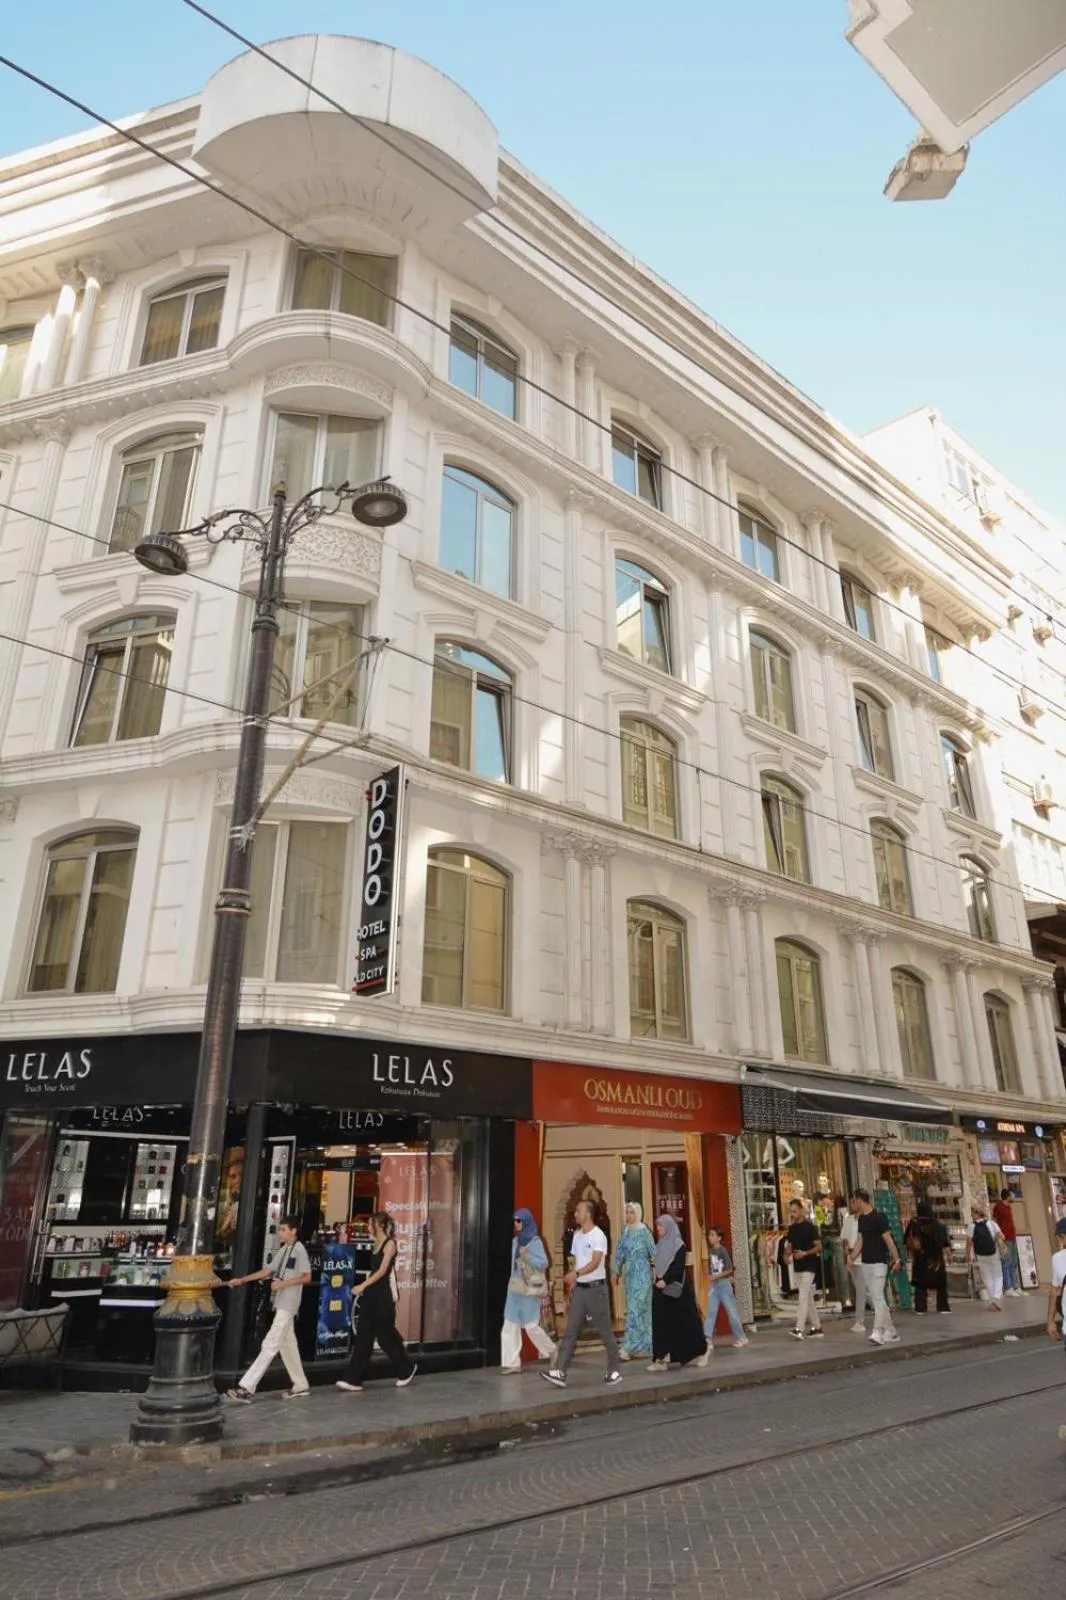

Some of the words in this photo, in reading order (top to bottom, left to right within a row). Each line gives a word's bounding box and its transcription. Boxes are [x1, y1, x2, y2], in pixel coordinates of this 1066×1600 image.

[364, 779, 387, 906] DODO
[360, 945, 377, 961] SPA
[366, 964, 384, 980] CITY
[6, 1048, 93, 1081] LELAS
[372, 1053, 454, 1087] LELAS
[583, 1078, 662, 1107] OSMANLI
[665, 1088, 703, 1110] OUD
